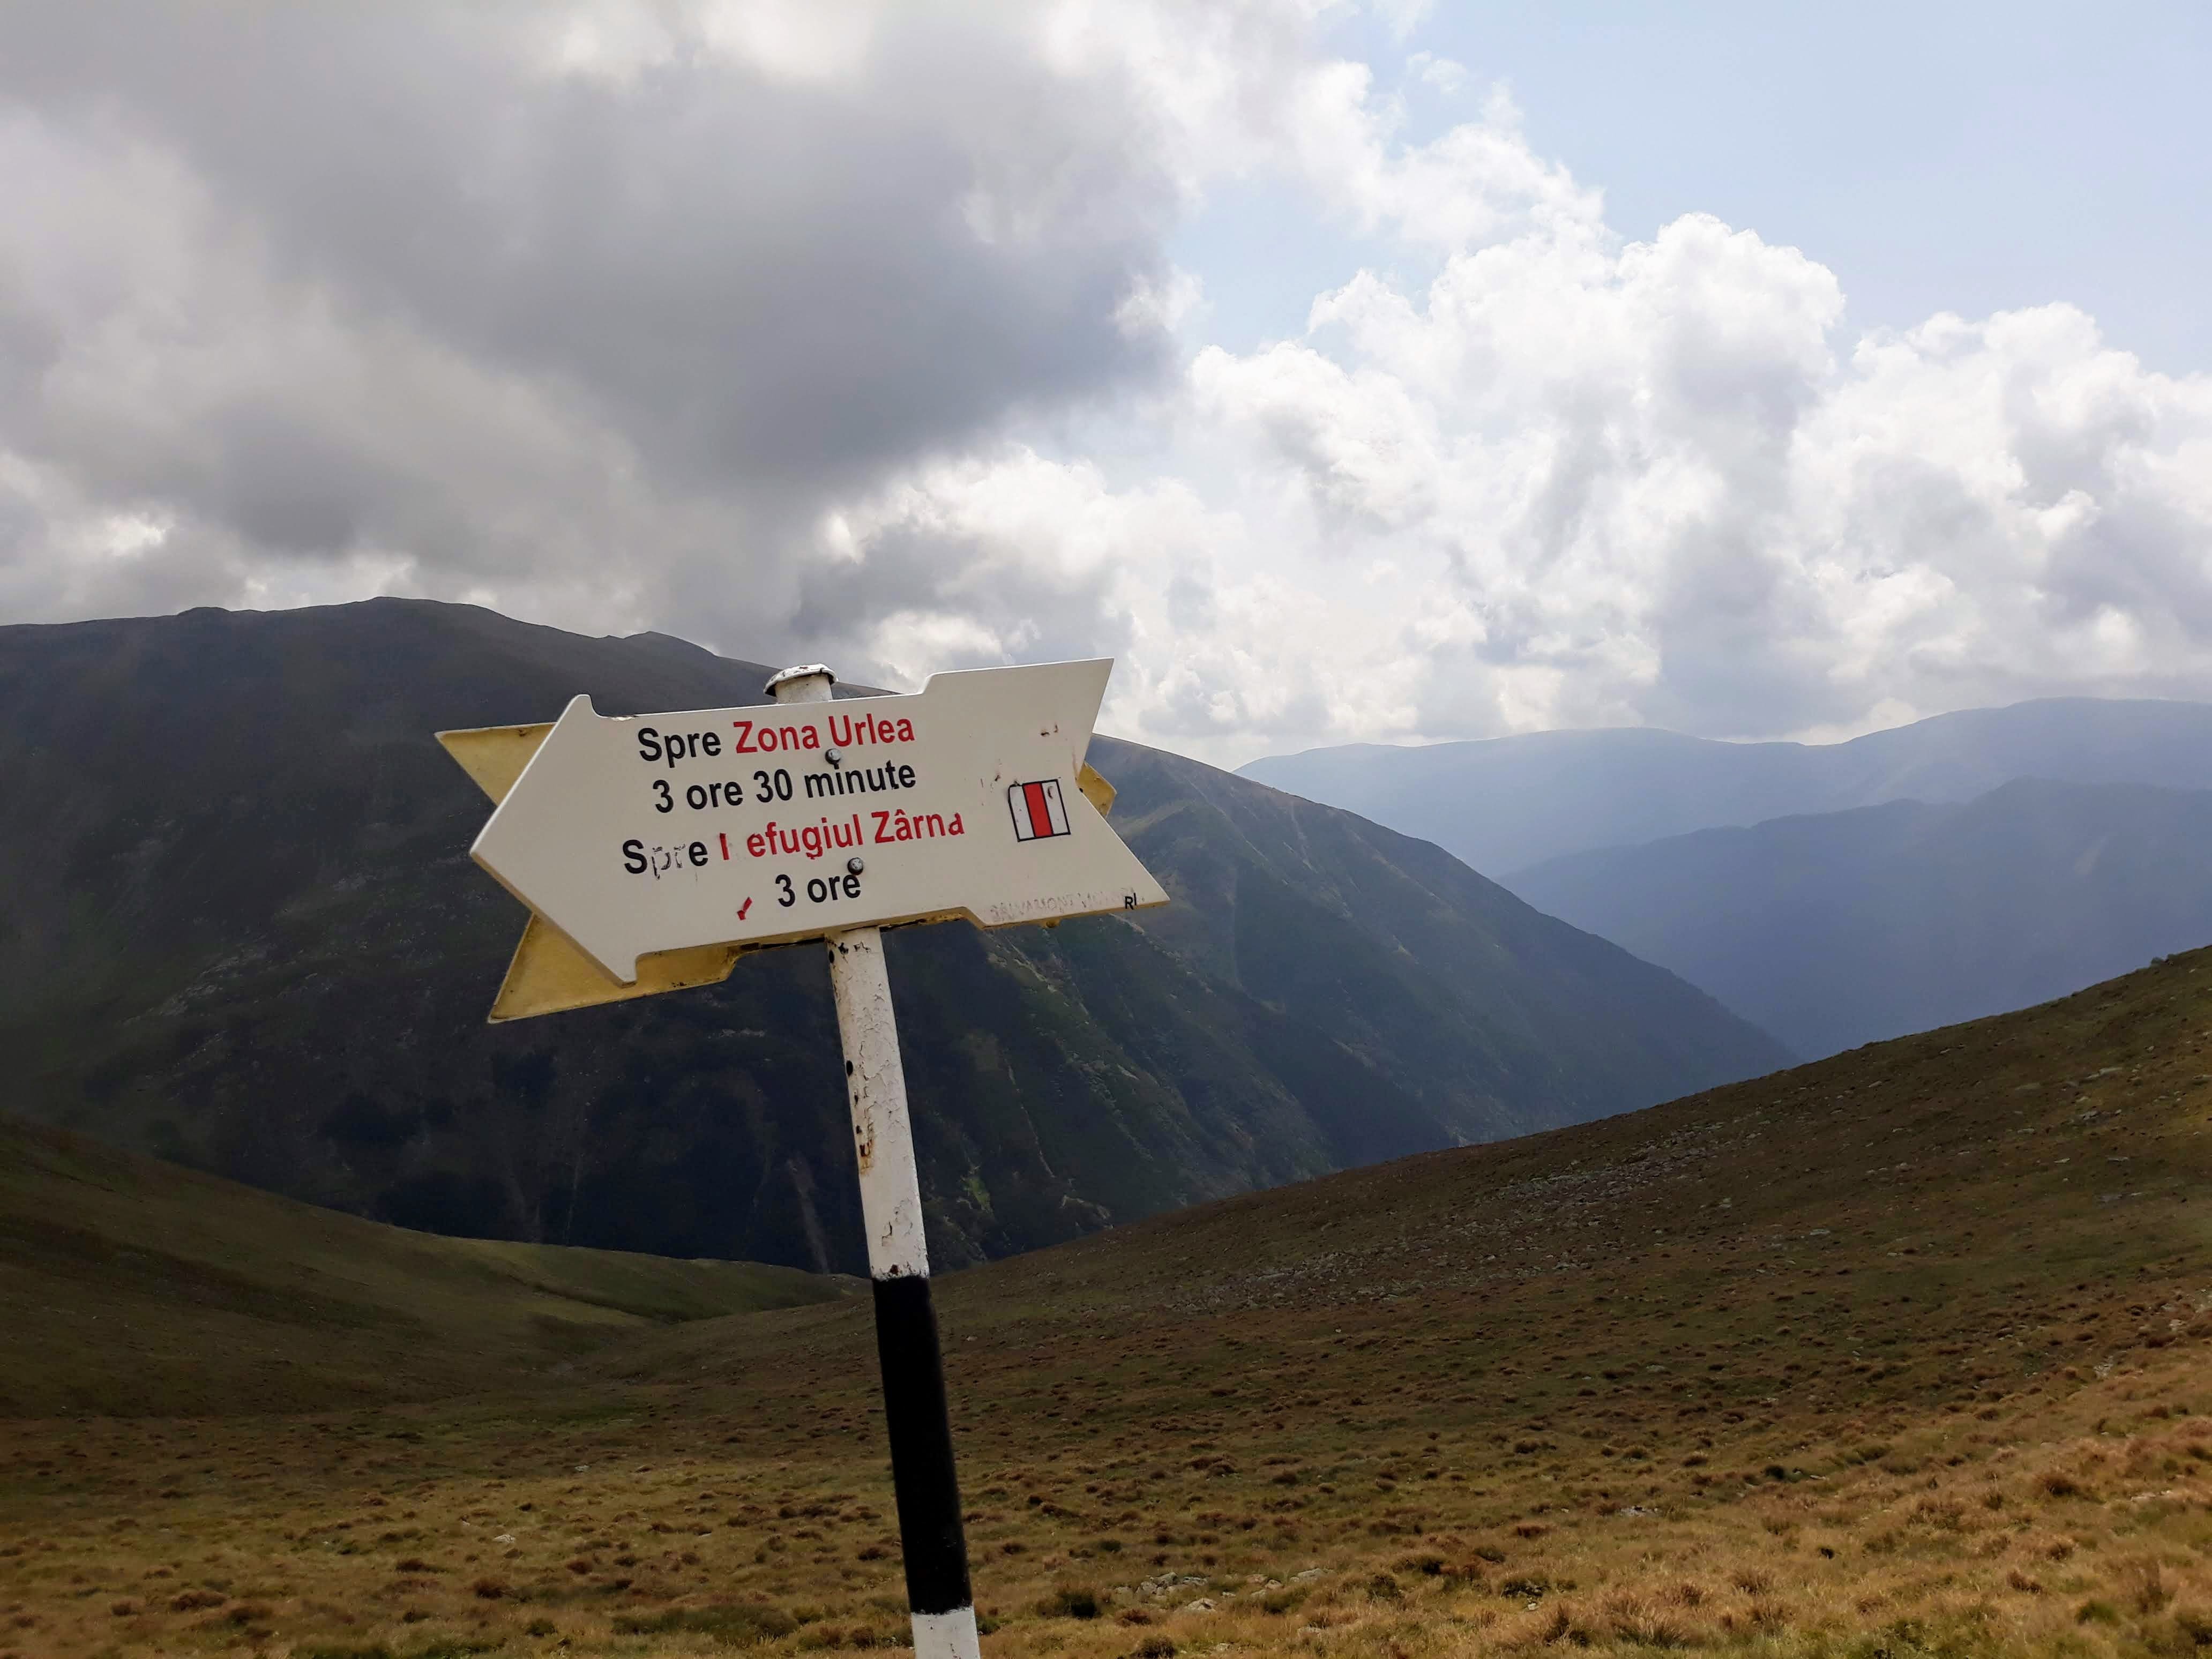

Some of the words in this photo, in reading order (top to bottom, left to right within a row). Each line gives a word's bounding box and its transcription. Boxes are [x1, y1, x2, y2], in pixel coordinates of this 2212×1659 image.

[638, 727, 721, 768] Spre
[733, 720, 821, 754] Zona
[828, 713, 916, 748] Urlea
[653, 779, 674, 813] 3
[686, 781, 743, 810] ore
[753, 768, 793, 803] 30
[804, 760, 916, 798] minute
[870, 809, 966, 844] Zârna
[775, 874, 796, 907] 3
[807, 874, 861, 903] ore
